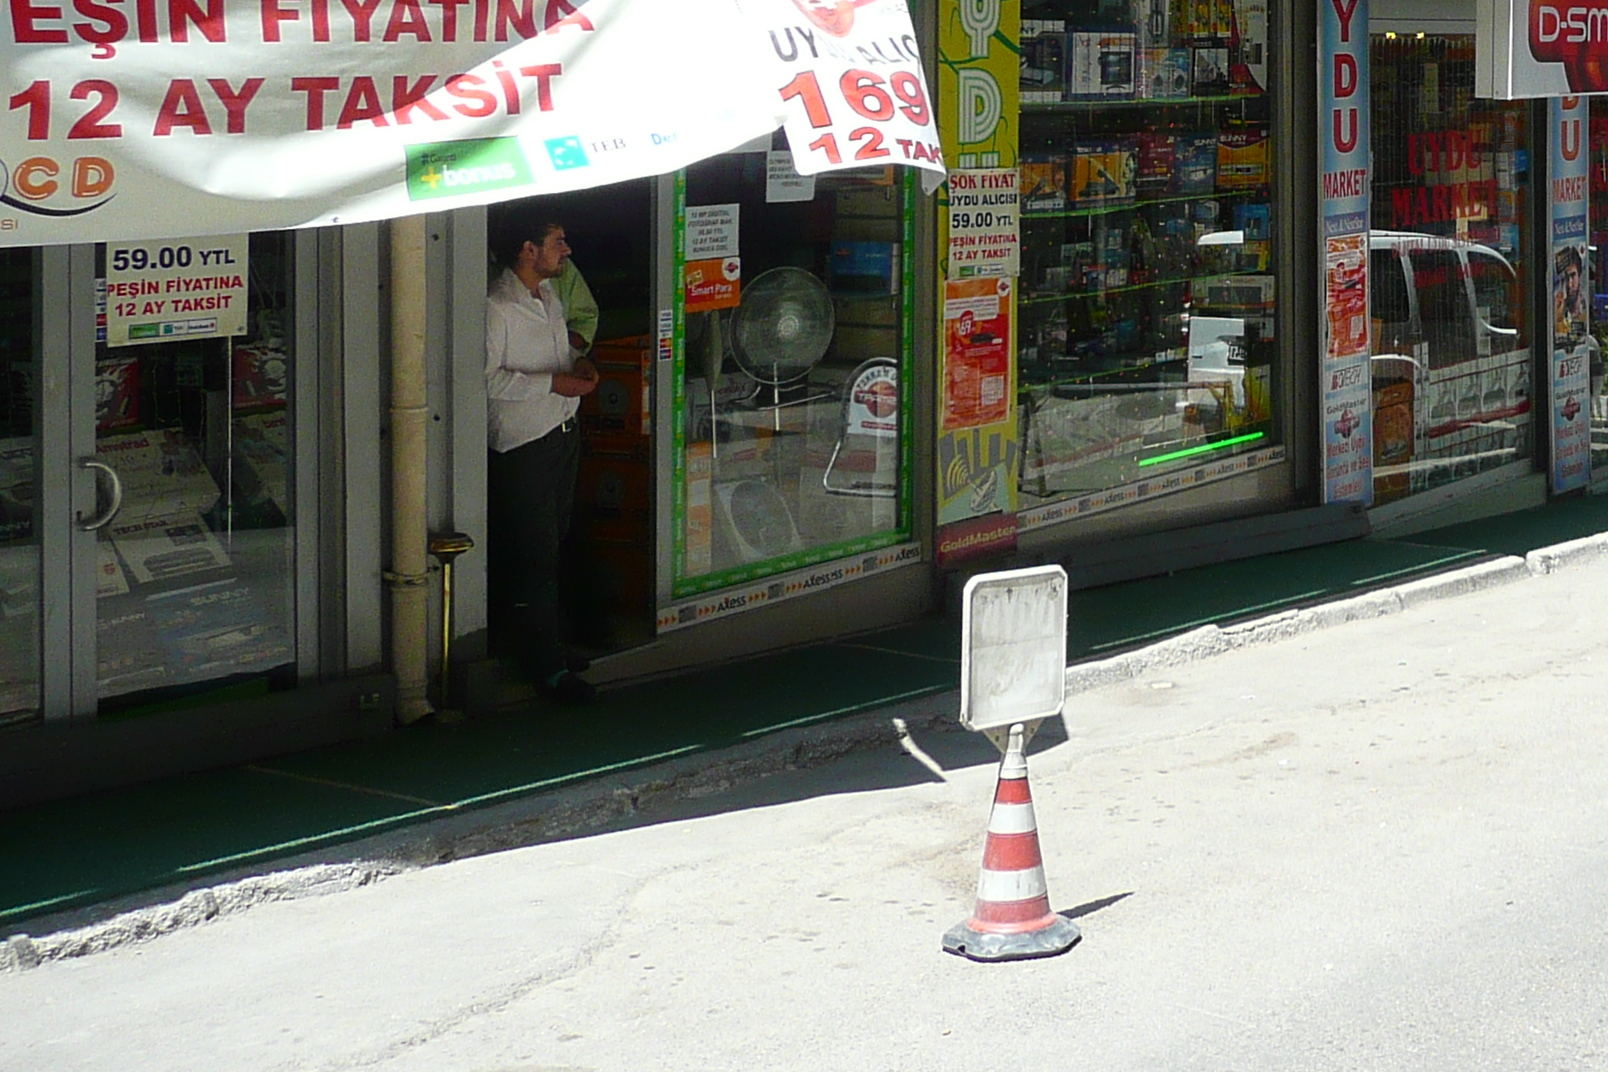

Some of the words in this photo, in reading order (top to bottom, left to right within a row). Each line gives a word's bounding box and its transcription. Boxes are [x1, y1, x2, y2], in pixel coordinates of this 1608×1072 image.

[9, 79, 123, 140] 12
[153, 77, 266, 136] AY
[291, 60, 562, 132] TAKSİT
[778, 67, 930, 129] 169
[590, 138, 627, 154] TEB
[809, 126, 891, 165] 12
[1408, 129, 1483, 176] UYDU
[443, 162, 517, 188] bonus
[949, 174, 977, 194] ŞOK
[981, 170, 1016, 189] FİYAT
[1324, 168, 1367, 199] MARKET
[981, 193, 1017, 205] ALICISI
[1553, 175, 1587, 204] MARKET
[1391, 179, 1498, 227] MARKET
[952, 212, 993, 228] 59.00
[995, 215, 1013, 226] YTL
[979, 233, 1017, 246] FİYATINA
[112, 246, 192, 272] 59.00
[198, 249, 236, 266] YTL
[953, 251, 962, 261] 12
[965, 250, 979, 260] AY
[107, 278, 160, 299] PEŞİN
[165, 274, 244, 294] FİYATINA
[691, 285, 714, 296] Smart
[115, 302, 137, 317] 12
[142, 300, 166, 316] AY
[171, 293, 233, 313] TAKSİT
[940, 526, 1016, 552] GoldMaster
